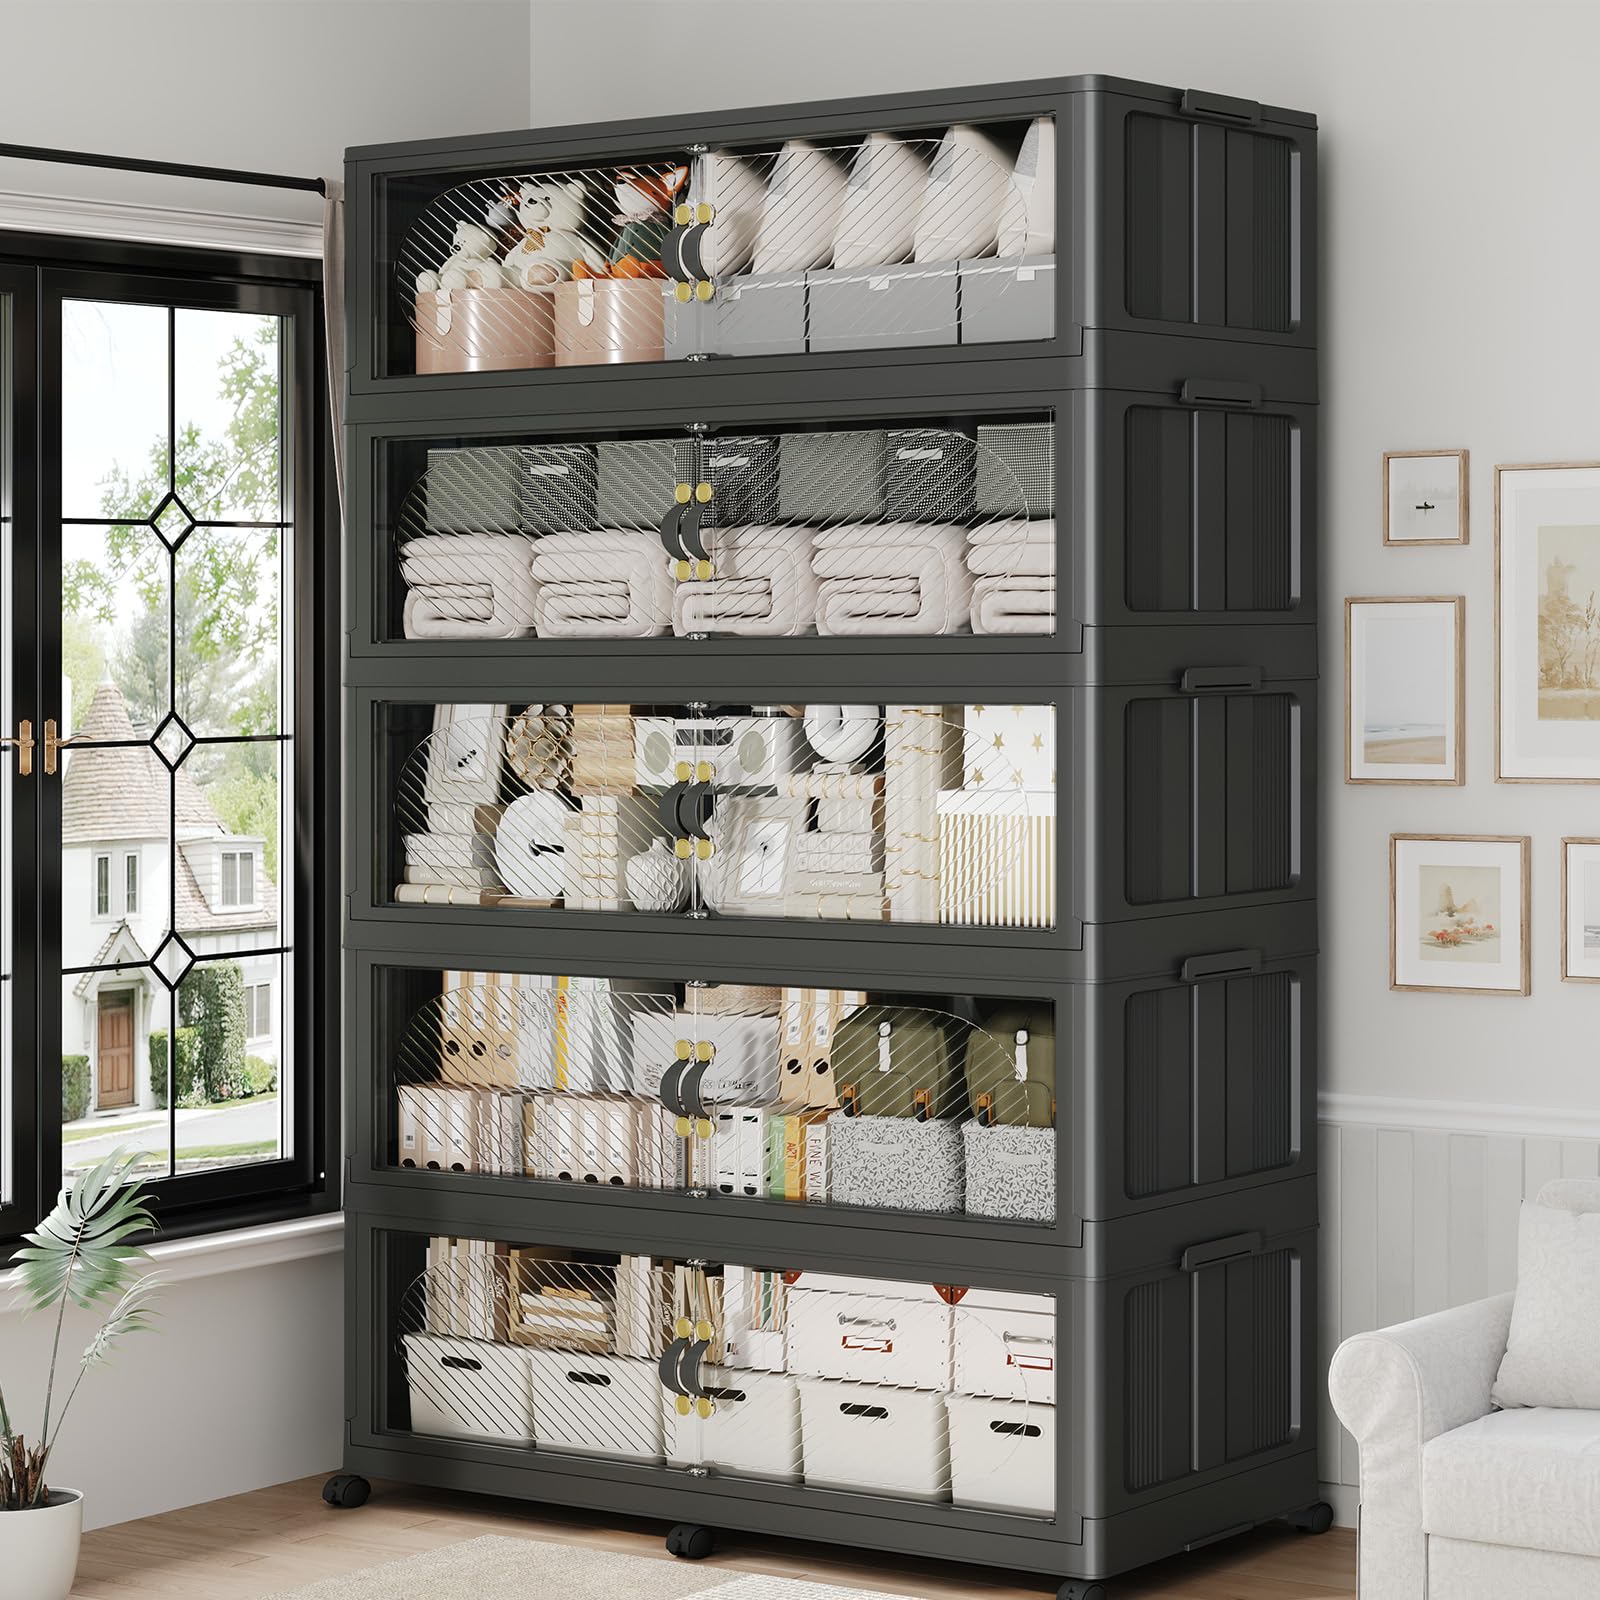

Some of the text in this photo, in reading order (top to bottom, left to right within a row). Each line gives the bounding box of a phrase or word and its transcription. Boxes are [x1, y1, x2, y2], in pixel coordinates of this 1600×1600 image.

[675, 1135, 683, 1179] NTERNATIONAL
[809, 1138, 823, 1204] FINE WINE
